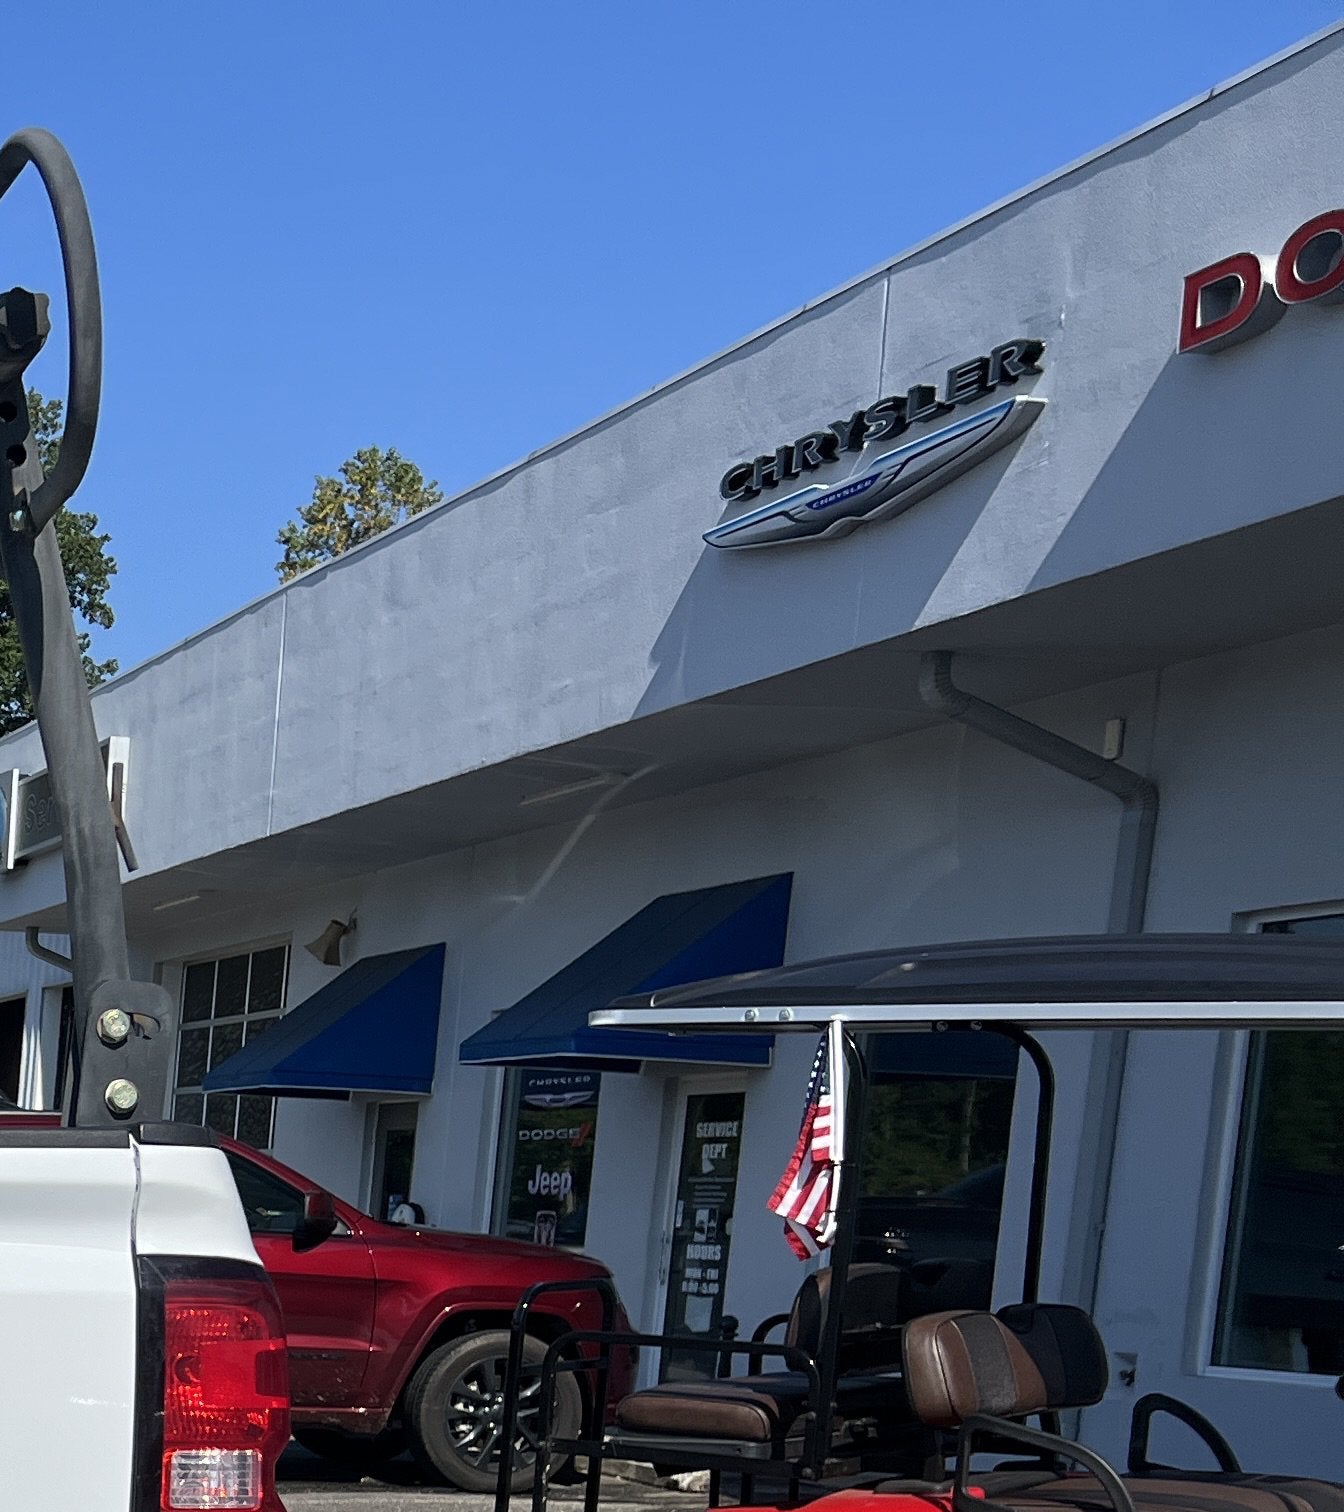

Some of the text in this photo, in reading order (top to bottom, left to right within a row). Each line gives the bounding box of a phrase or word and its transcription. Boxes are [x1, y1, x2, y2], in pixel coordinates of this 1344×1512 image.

[719, 338, 1047, 501] CHRYSLER
[519, 1127, 580, 1141] DODGE
[695, 1120, 739, 1138] SERVICE
[527, 1164, 572, 1200] Jeep
[686, 1244, 722, 1261] HOURS
